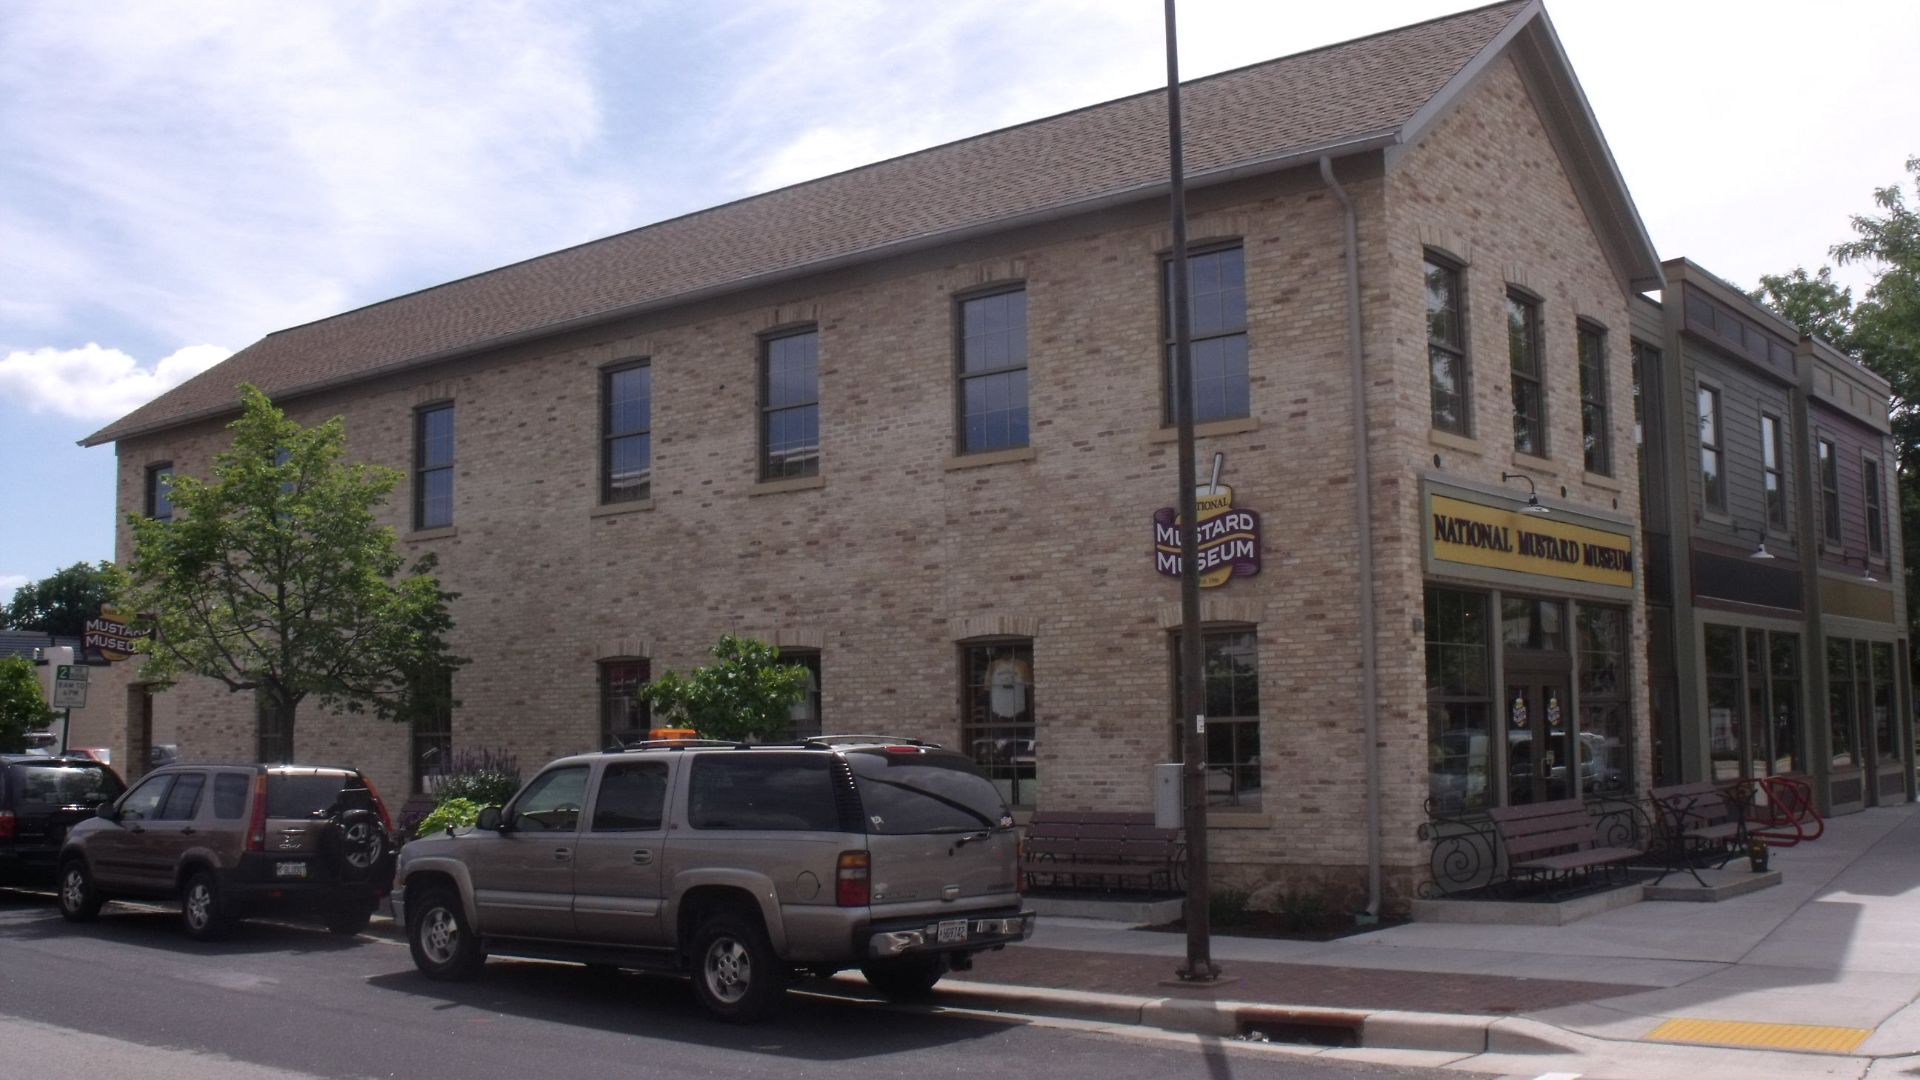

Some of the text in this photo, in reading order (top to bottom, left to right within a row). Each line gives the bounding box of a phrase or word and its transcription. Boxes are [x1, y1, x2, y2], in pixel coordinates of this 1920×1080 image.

[1196, 497, 1229, 512] TIONAL
[1156, 513, 1255, 546] MTARD
[1433, 513, 1633, 573] NATIONAL MUSTARD MUSEUM
[1157, 540, 1255, 575] MSEUM
[86, 634, 137, 652] MUSEU
[60, 666, 68, 679] 2
